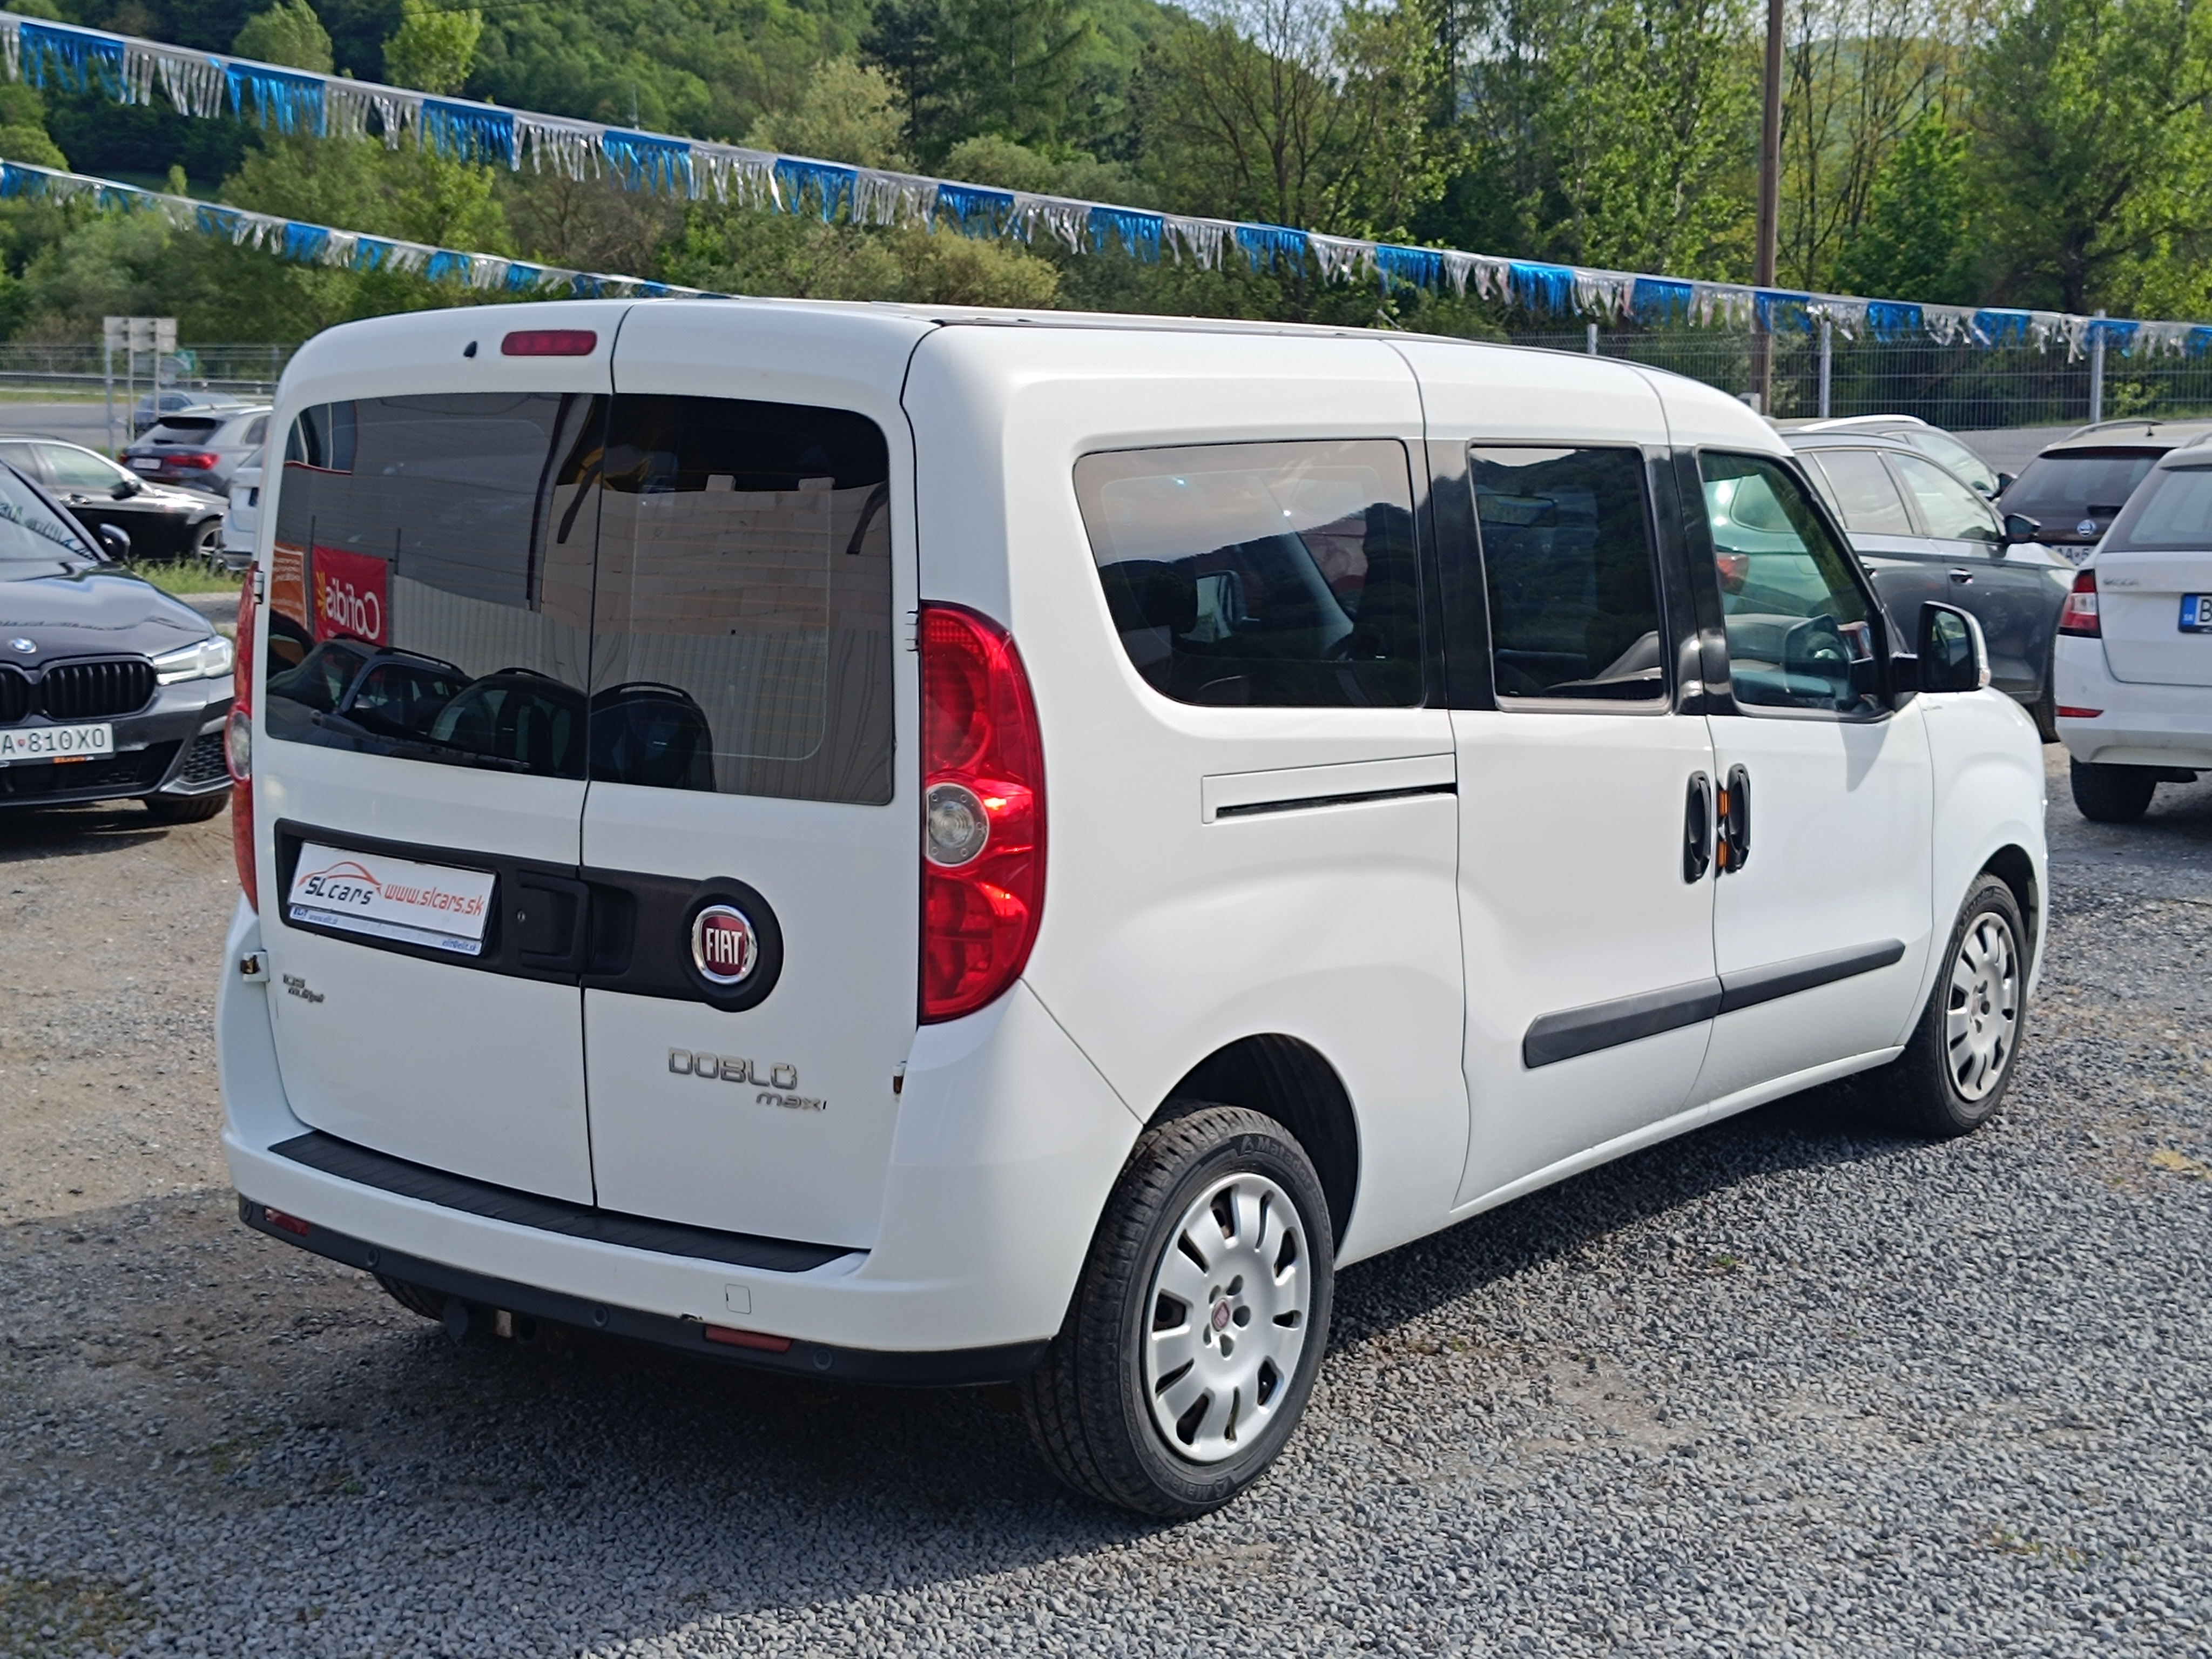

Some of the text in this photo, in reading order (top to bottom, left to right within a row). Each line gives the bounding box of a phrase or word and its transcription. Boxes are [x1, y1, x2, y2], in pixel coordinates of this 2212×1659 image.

[385, 884, 485, 916] www.slcars.sk
[706, 927, 743, 965] FIAT
[756, 1092, 827, 1111] maxi
